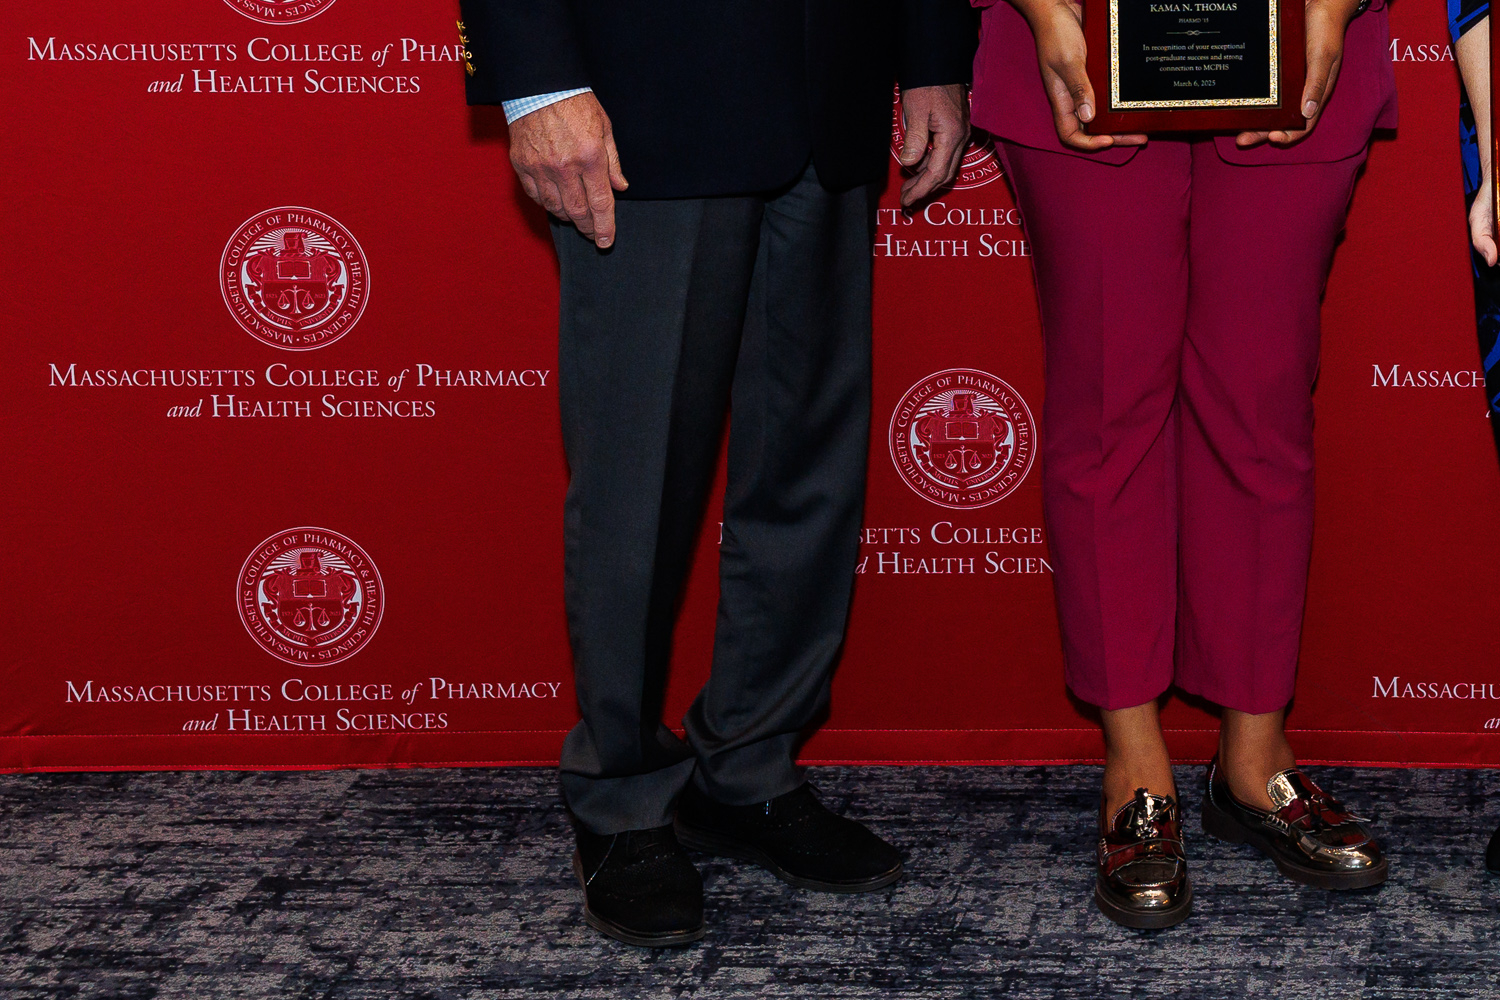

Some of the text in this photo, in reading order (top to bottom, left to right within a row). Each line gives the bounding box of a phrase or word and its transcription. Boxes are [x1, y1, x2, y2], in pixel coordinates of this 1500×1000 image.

[1150, 2, 1238, 13] KAMA N. THOMAS
[1151, 43, 1186, 52] recognition
[1210, 42, 1245, 51] exceptional
[49, 364, 549, 391] MASSACHUSETTS COLLEGE of PHARMACY
[167, 394, 435, 417] and HEALTH SCIENCES
[931, 522, 1043, 544] COLLEGE
[877, 552, 975, 573] HEALTH
